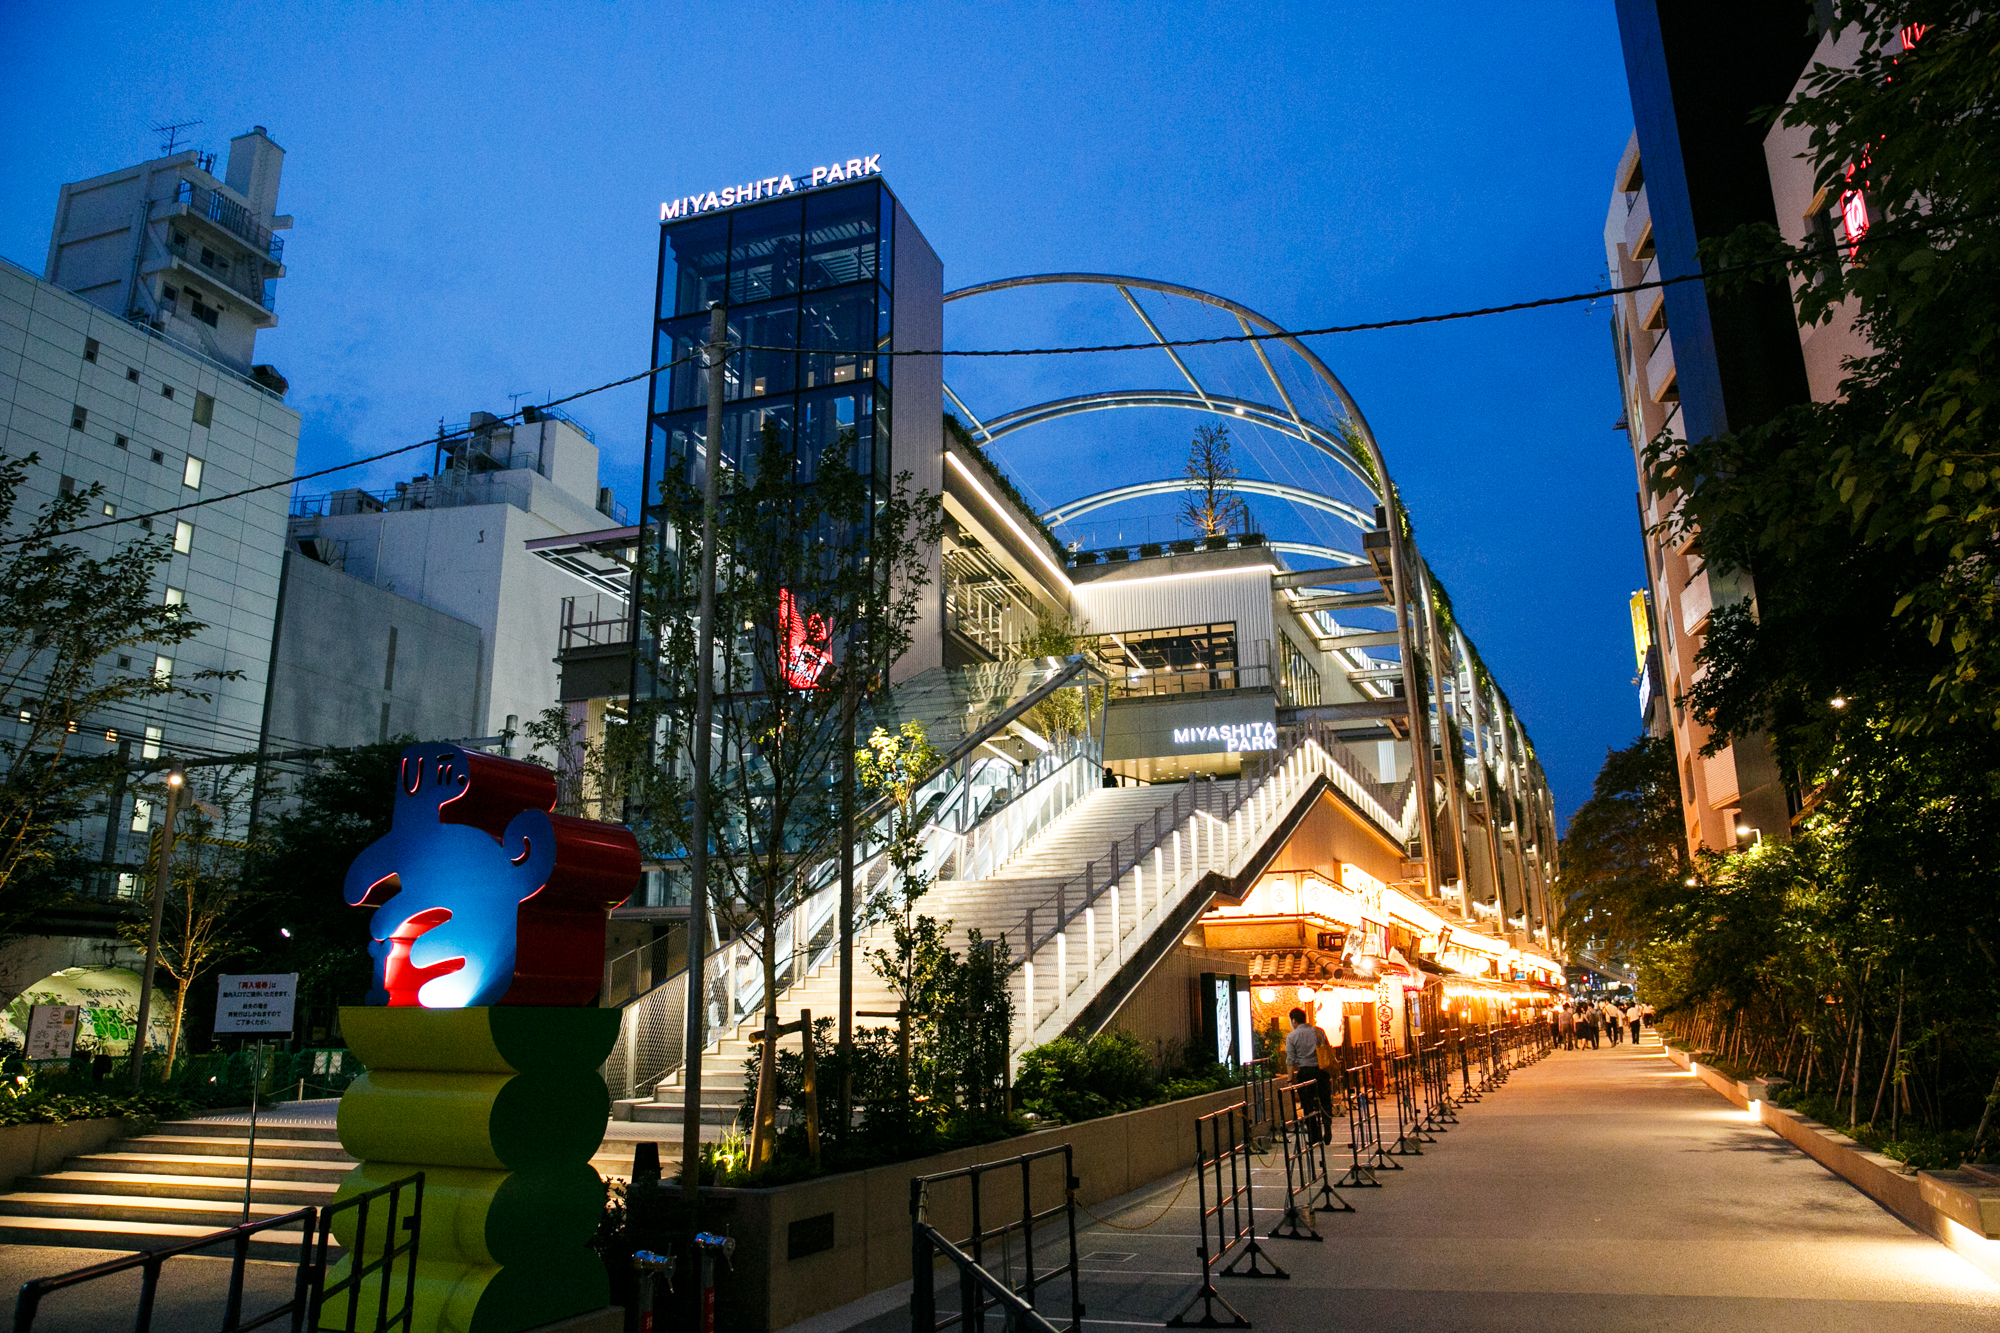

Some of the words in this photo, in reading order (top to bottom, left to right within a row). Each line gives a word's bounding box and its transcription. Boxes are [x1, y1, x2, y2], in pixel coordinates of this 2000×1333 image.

[660, 174, 795, 221] MIYASHITA
[811, 153, 882, 187] PARK
[1173, 721, 1277, 744] MIYASHITA
[1227, 735, 1278, 752] PARK
